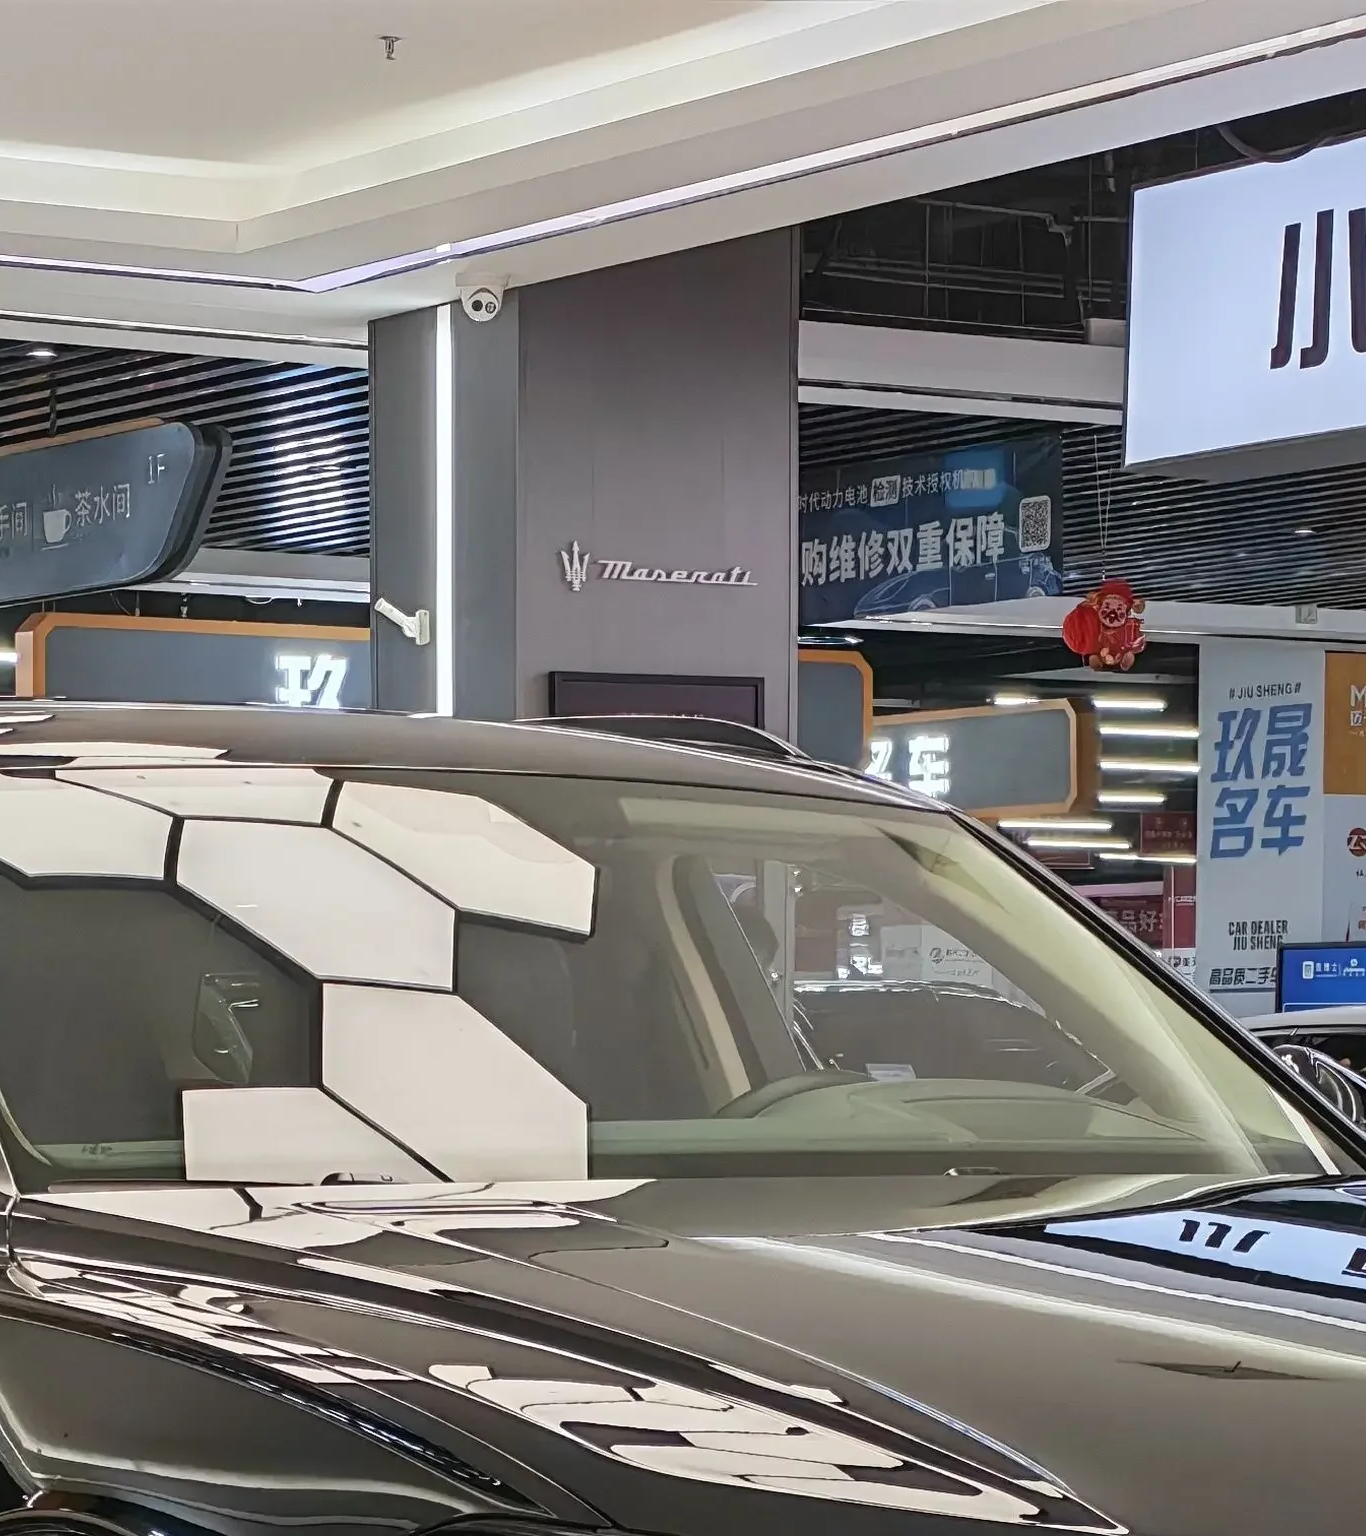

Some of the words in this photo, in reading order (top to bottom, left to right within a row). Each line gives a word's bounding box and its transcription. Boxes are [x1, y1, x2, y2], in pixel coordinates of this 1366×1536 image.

[74, 483, 131, 526] 茶水间
[801, 511, 1005, 586] 购维修双重保障
[596, 559, 758, 585] Maserati
[1210, 703, 1313, 784] 玖晟
[1209, 784, 1311, 860] 名车
[1229, 922, 1248, 936] CAR
[1251, 919, 1288, 935] DEALER
[1233, 936, 1248, 951] JIU
